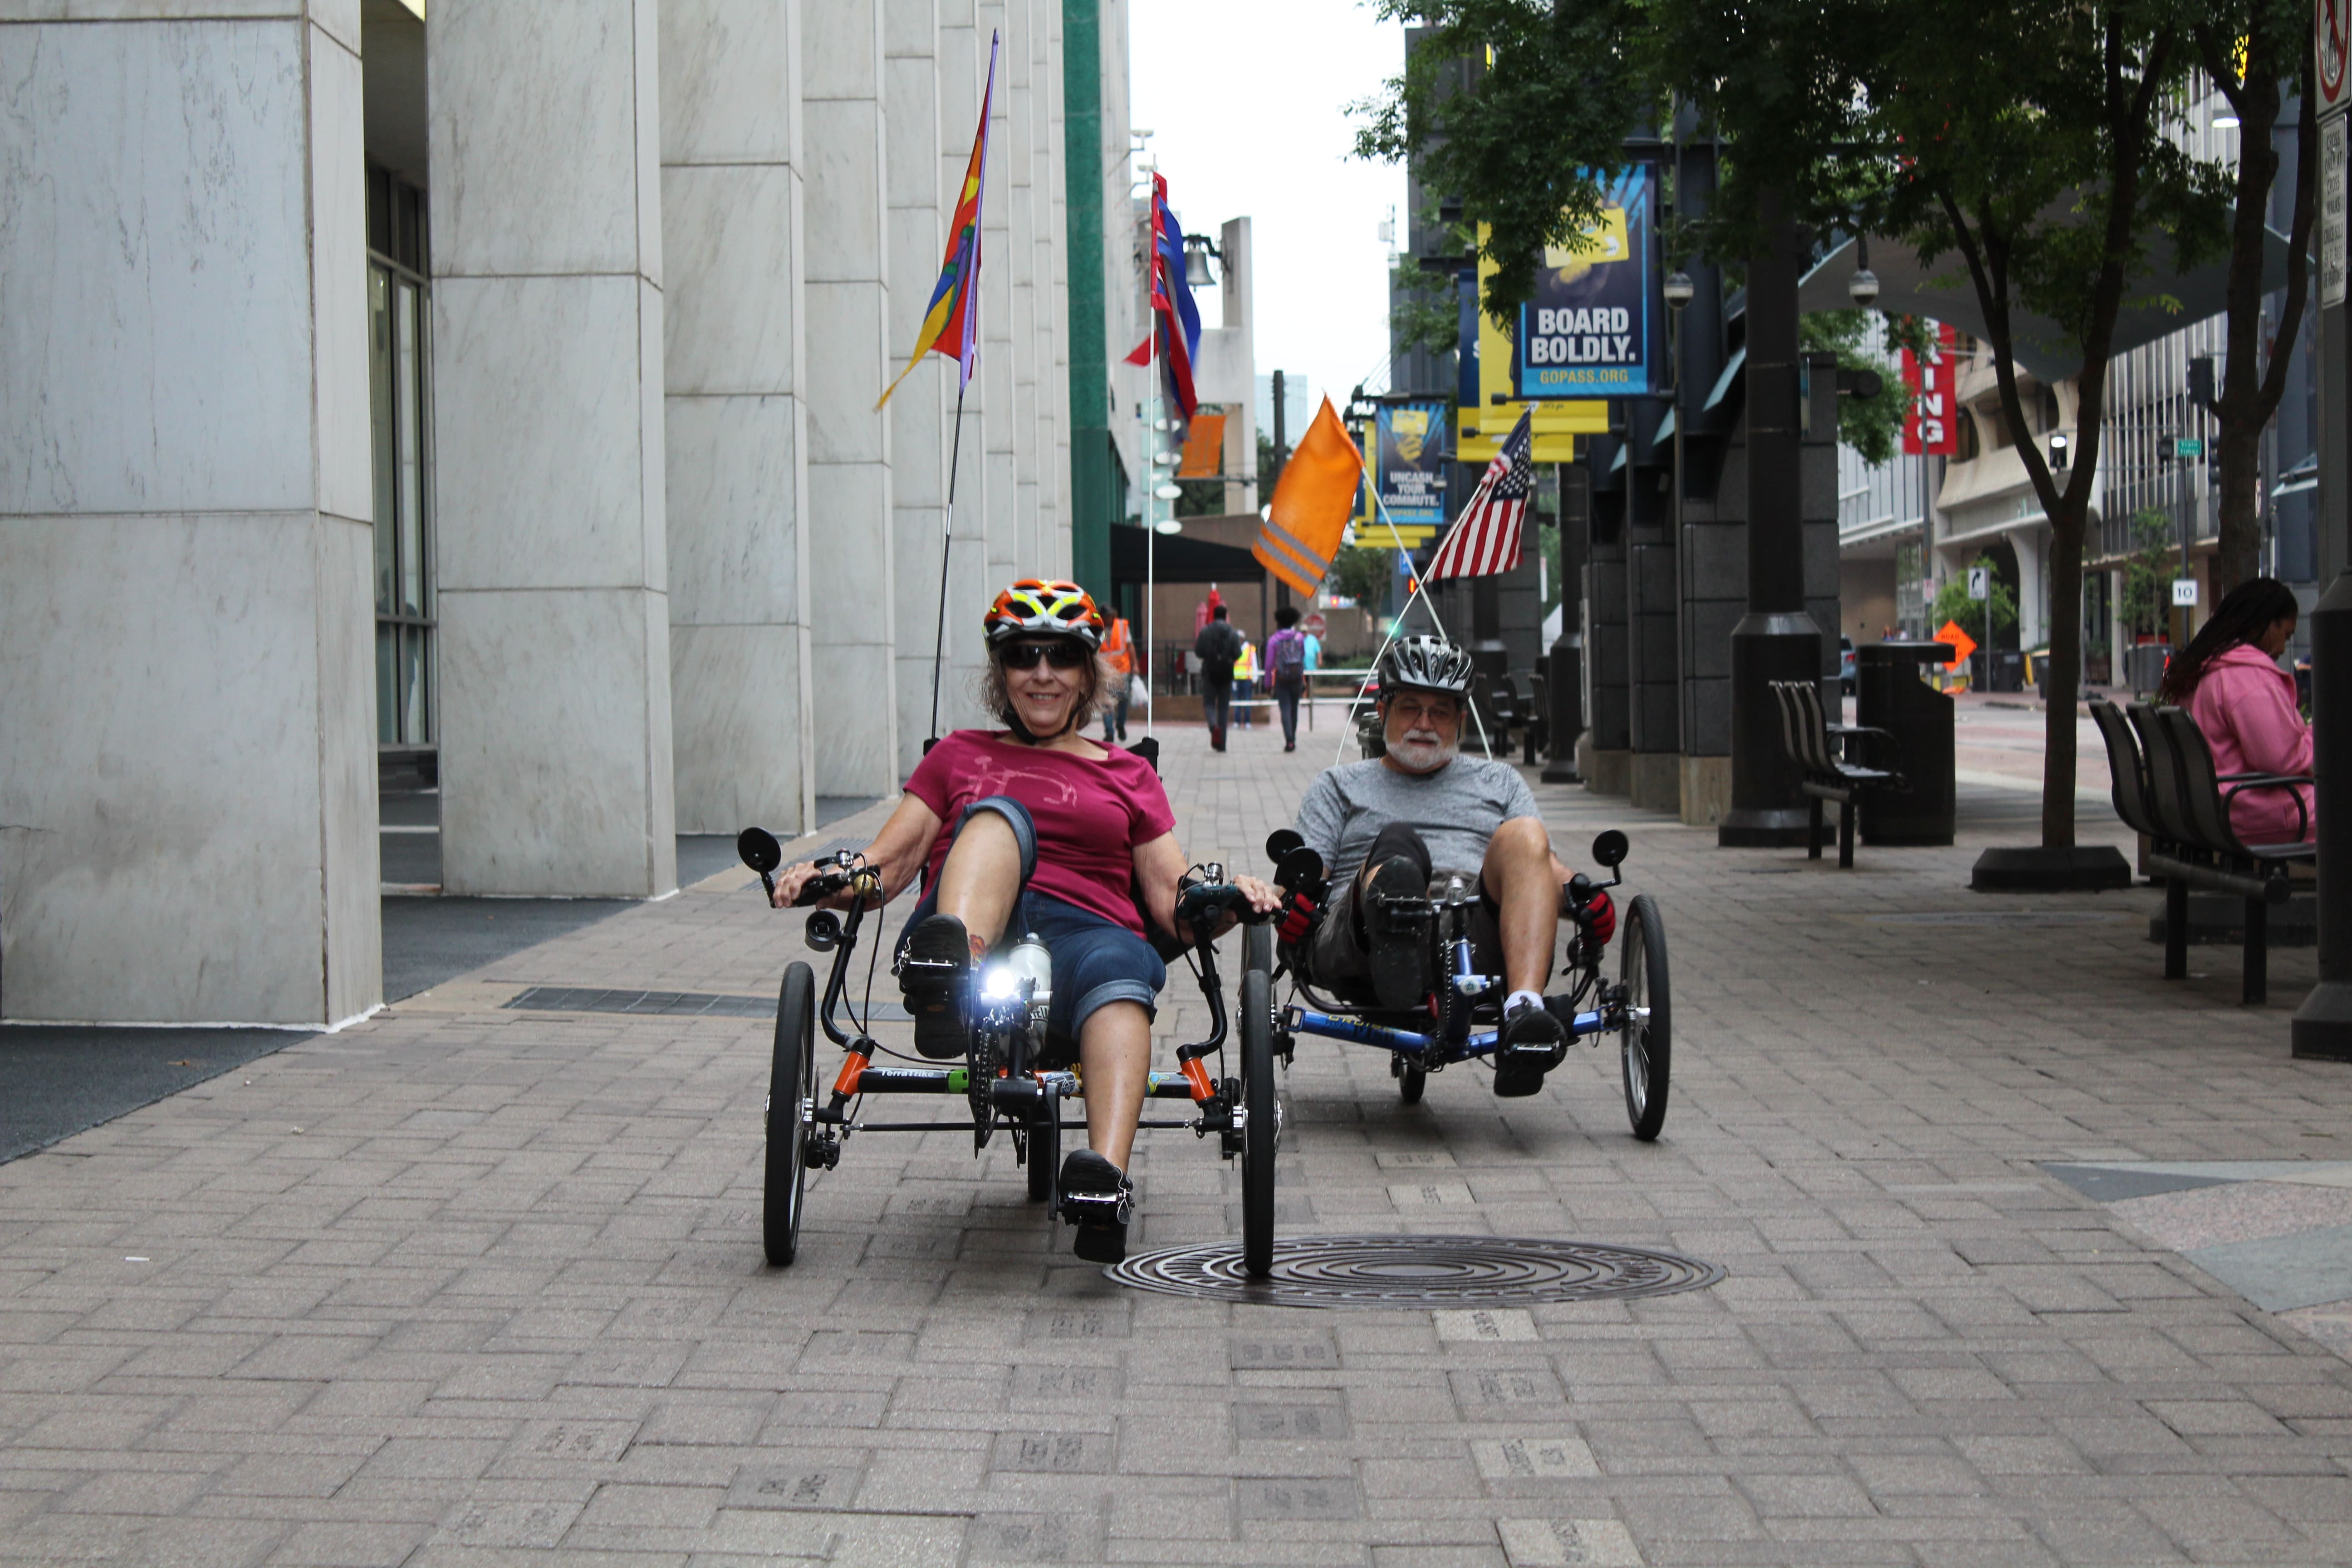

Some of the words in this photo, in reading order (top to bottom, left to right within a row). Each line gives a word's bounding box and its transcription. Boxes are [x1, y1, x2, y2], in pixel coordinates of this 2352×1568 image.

[2327, 130, 2340, 151] CROSS
[2327, 175, 2340, 194] CROSS
[1538, 307, 1629, 335] BOARD
[1532, 336, 1636, 364] BOLDLY.
[1540, 368, 1628, 384] GOPASS.ORG
[1390, 472, 1433, 484] UNCASH
[1397, 484, 1426, 494] YOUR
[1383, 494, 1440, 506] COMMUTE.
[2178, 587, 2192, 598] 10
